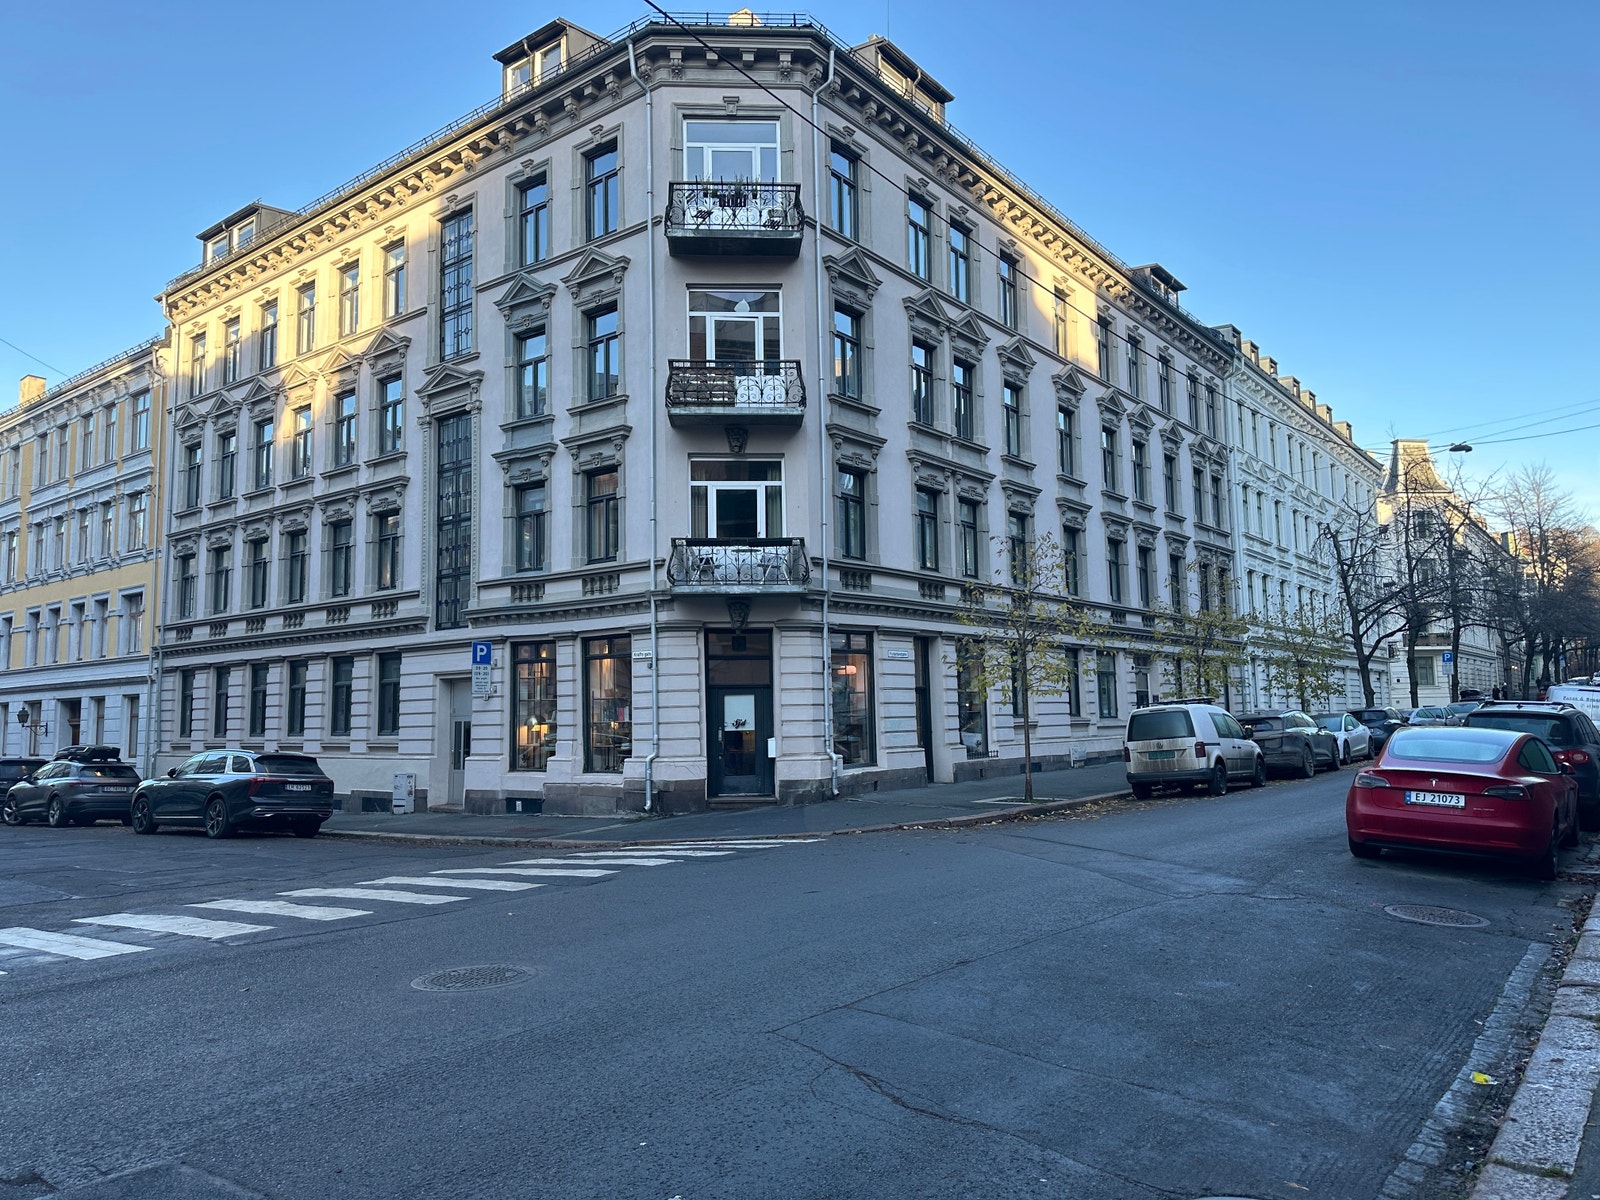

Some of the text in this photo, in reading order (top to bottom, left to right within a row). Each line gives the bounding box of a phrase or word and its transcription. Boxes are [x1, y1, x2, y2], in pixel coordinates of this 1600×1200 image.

[477, 645, 488, 661] P
[1444, 653, 1451, 661] P
[1415, 792, 1460, 804] EJ 21073
